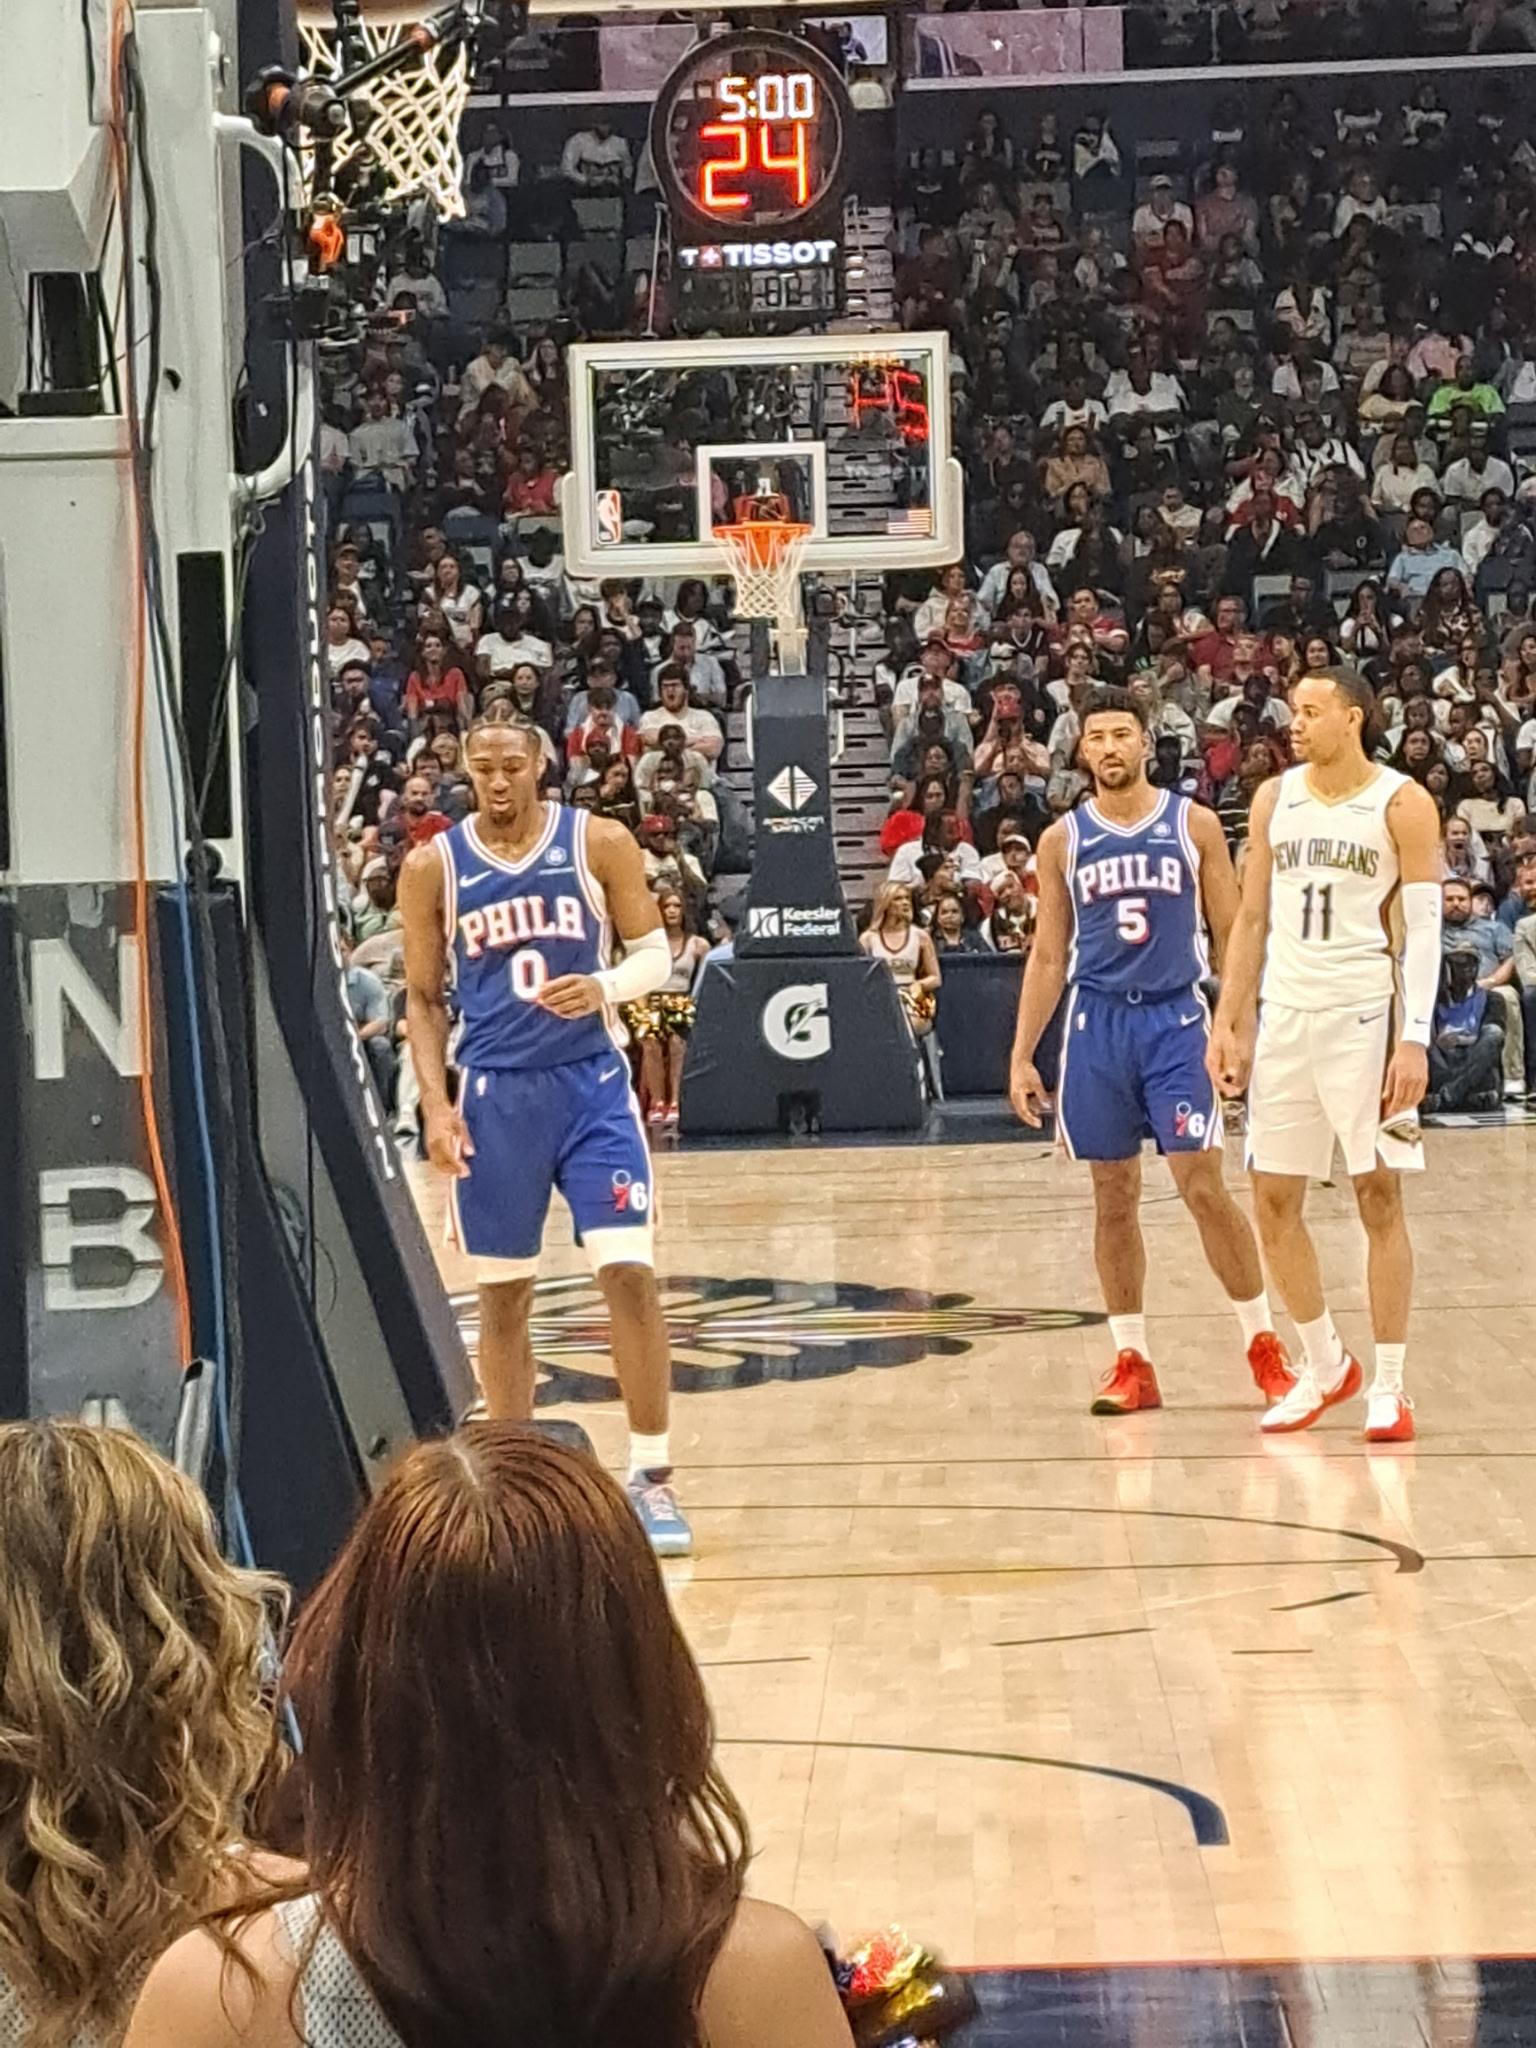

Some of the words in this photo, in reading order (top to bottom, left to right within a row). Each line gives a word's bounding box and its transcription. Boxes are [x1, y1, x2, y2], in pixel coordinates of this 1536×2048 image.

[719, 73, 815, 120] 5:00
[701, 122, 811, 207] 24
[727, 241, 837, 267] TISSOT
[1077, 853, 1183, 905] PHILA
[1306, 837, 1380, 878] ORLEANS
[458, 895, 587, 959] PHILA
[783, 906, 840, 921] Keesler
[783, 921, 840, 936] Federal
[1116, 898, 1150, 945] 5
[1301, 881, 1332, 941] 11
[511, 949, 548, 1001] 0
[1174, 1112, 1207, 1138] 76
[611, 1181, 649, 1212] 76
